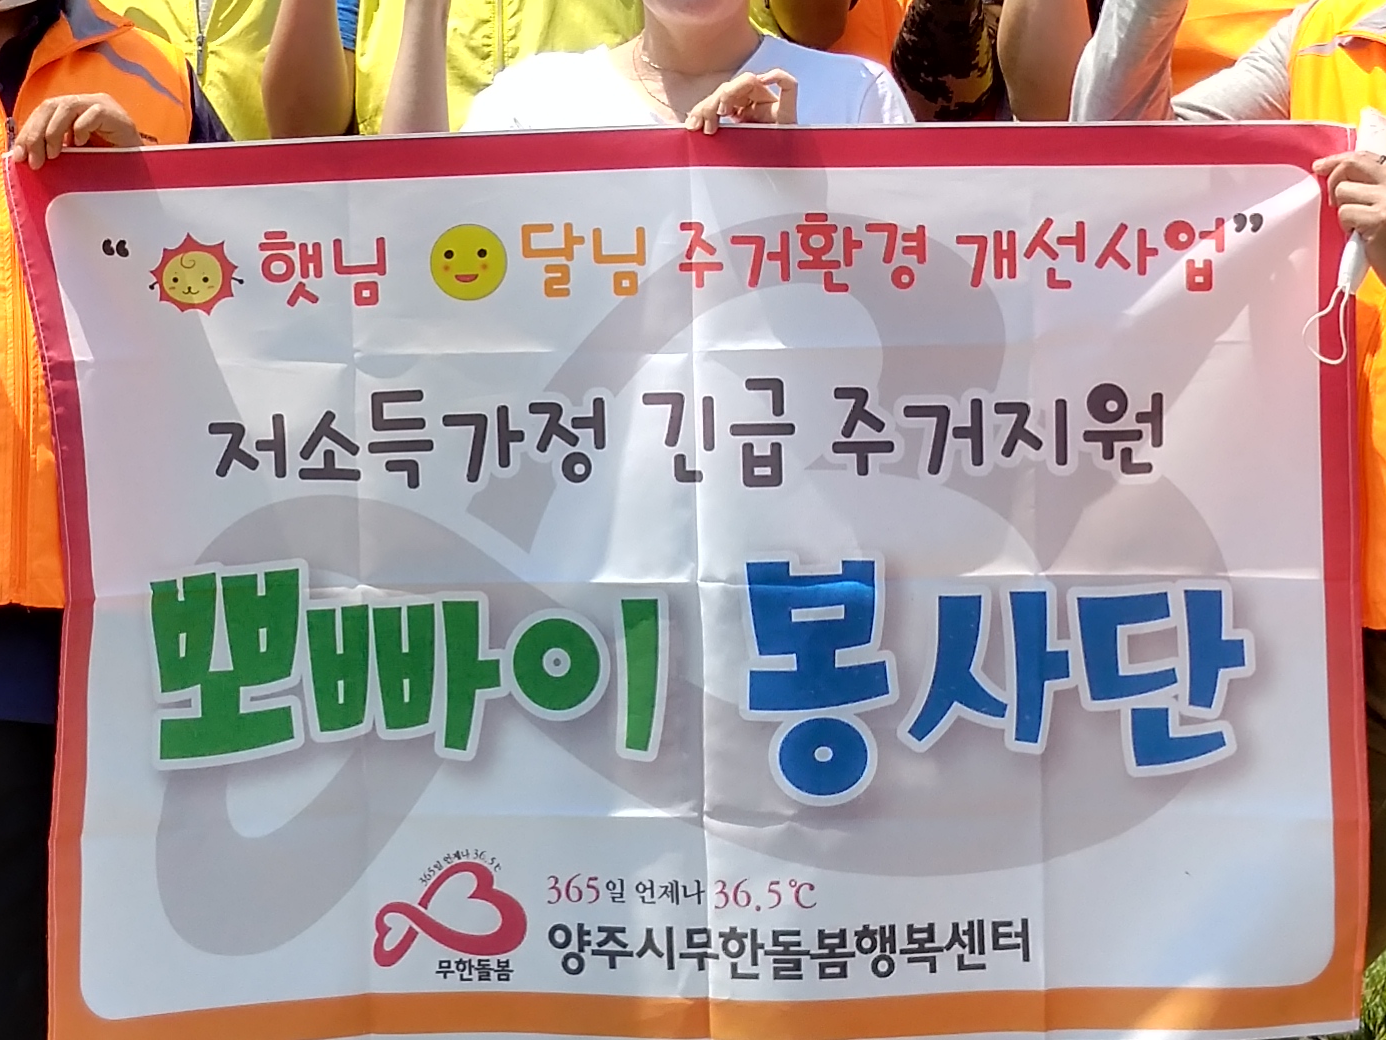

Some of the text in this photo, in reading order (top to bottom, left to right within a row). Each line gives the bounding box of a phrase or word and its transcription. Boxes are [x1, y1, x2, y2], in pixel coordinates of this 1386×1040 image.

[258, 230, 386, 307] 햇님
[520, 221, 647, 298] 달님
[677, 212, 928, 294] 주거환경
[208, 376, 1165, 490] 저소득가정 긴급 주거지원
[149, 559, 1249, 798] 뽀빠이 봉사단
[546, 873, 626, 905] 365일
[634, 878, 706, 906] 언제나
[434, 957, 515, 983] 무한돌봄
[547, 916, 1031, 982] 양주시무한돌봄행복센터
